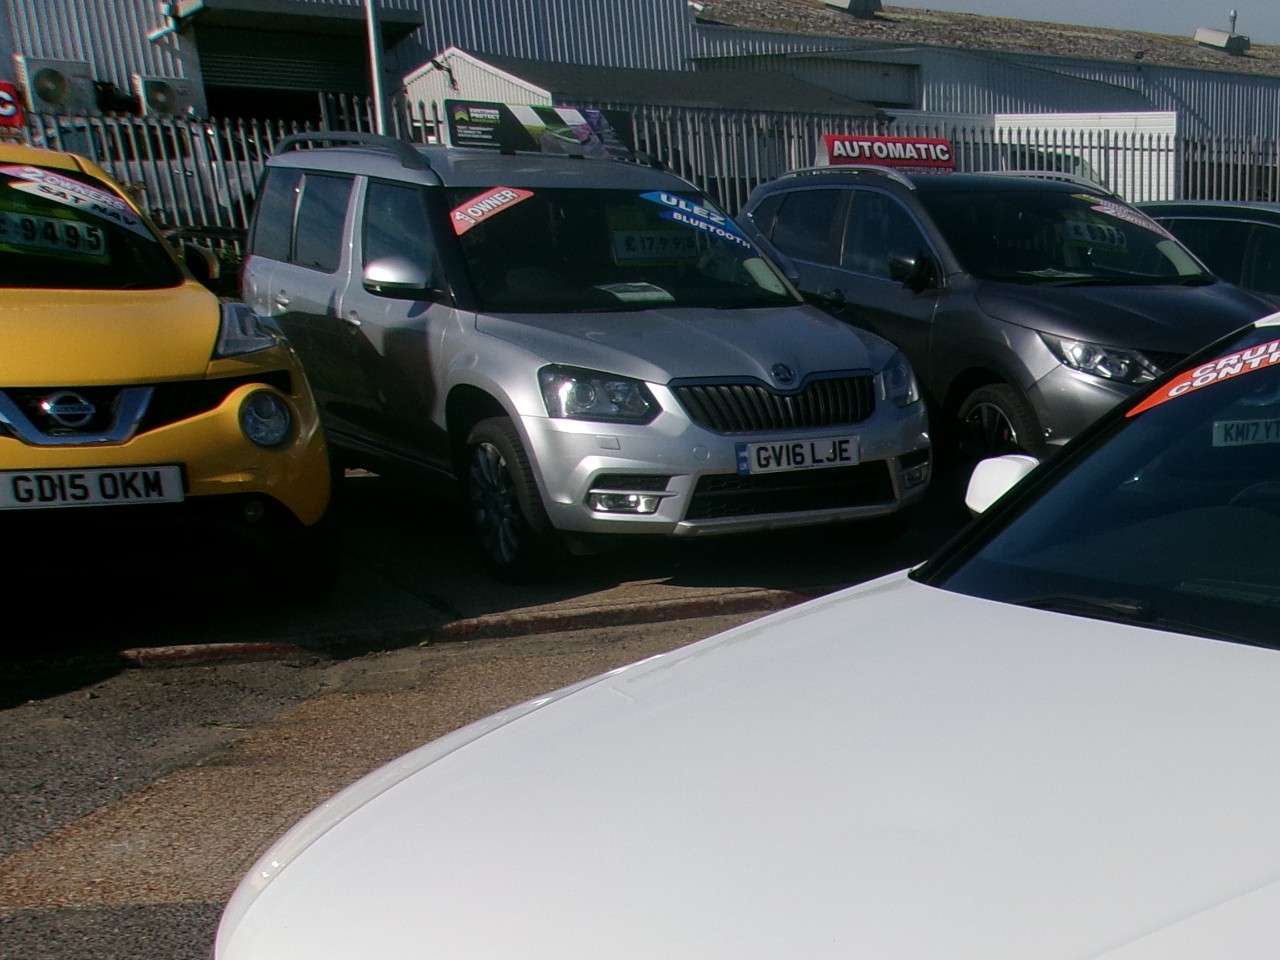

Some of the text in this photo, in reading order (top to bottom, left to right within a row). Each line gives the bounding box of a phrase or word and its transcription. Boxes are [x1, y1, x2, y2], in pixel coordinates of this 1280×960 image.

[832, 140, 950, 160] AUTOMATIC
[468, 189, 518, 218] OWNER
[659, 193, 726, 226] ULEZ
[671, 211, 751, 250] BLUETOOTH
[756, 440, 852, 469] GV16 LJE
[12, 470, 164, 503] GD15 OKM
